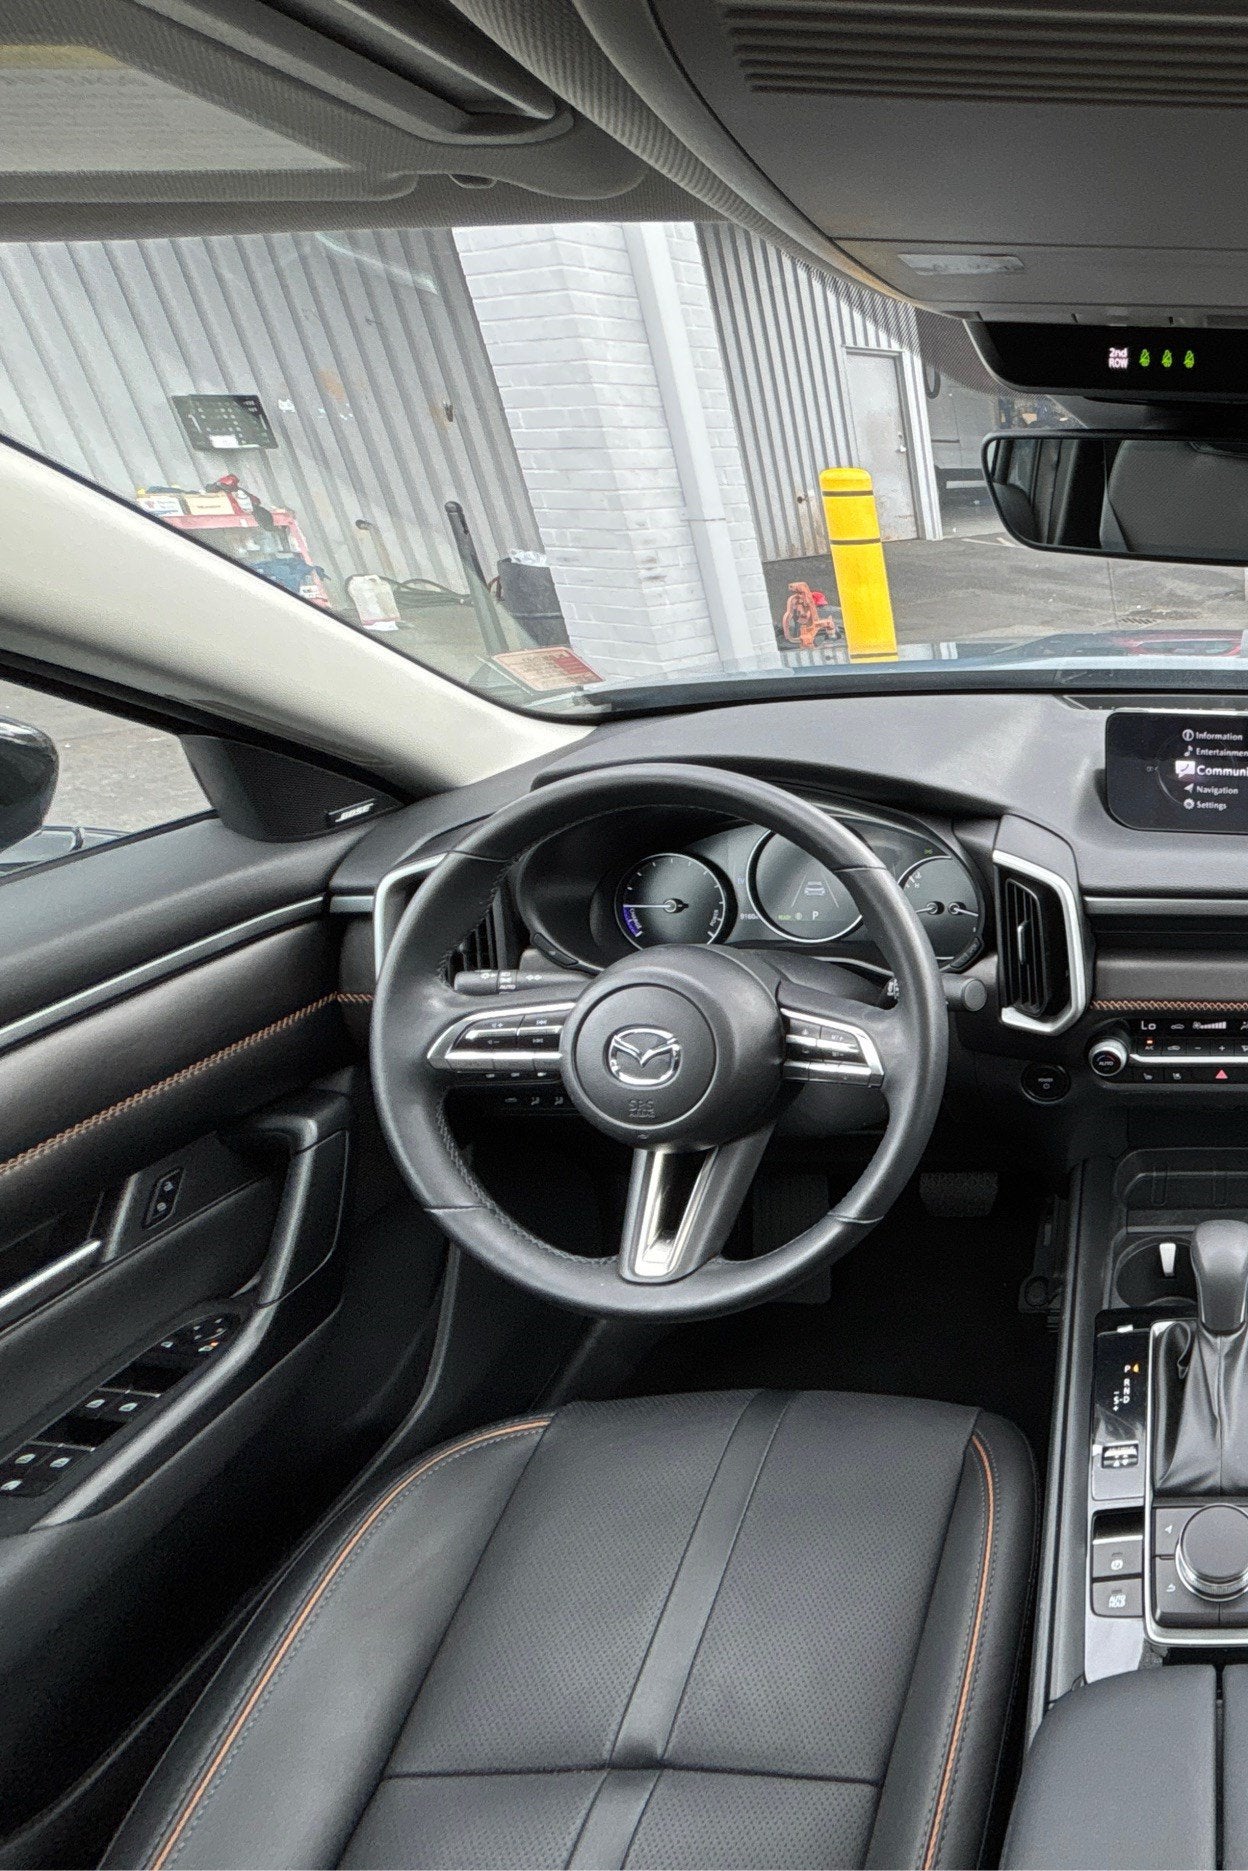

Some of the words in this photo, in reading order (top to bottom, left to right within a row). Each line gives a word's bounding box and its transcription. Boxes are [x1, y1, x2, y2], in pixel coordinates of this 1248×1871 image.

[1109, 347, 1128, 358] 2nd
[1108, 358, 1129, 369] ROW
[1195, 731, 1243, 741] Information
[1196, 785, 1239, 796] Navigation
[1196, 801, 1227, 811] Settings
[1141, 1020, 1157, 1031] Lo
[1124, 1364, 1131, 1373] P
[1123, 1378, 1130, 1386] R
[1123, 1387, 1130, 1395] N
[1109, 1594, 1126, 1602] AUTO
